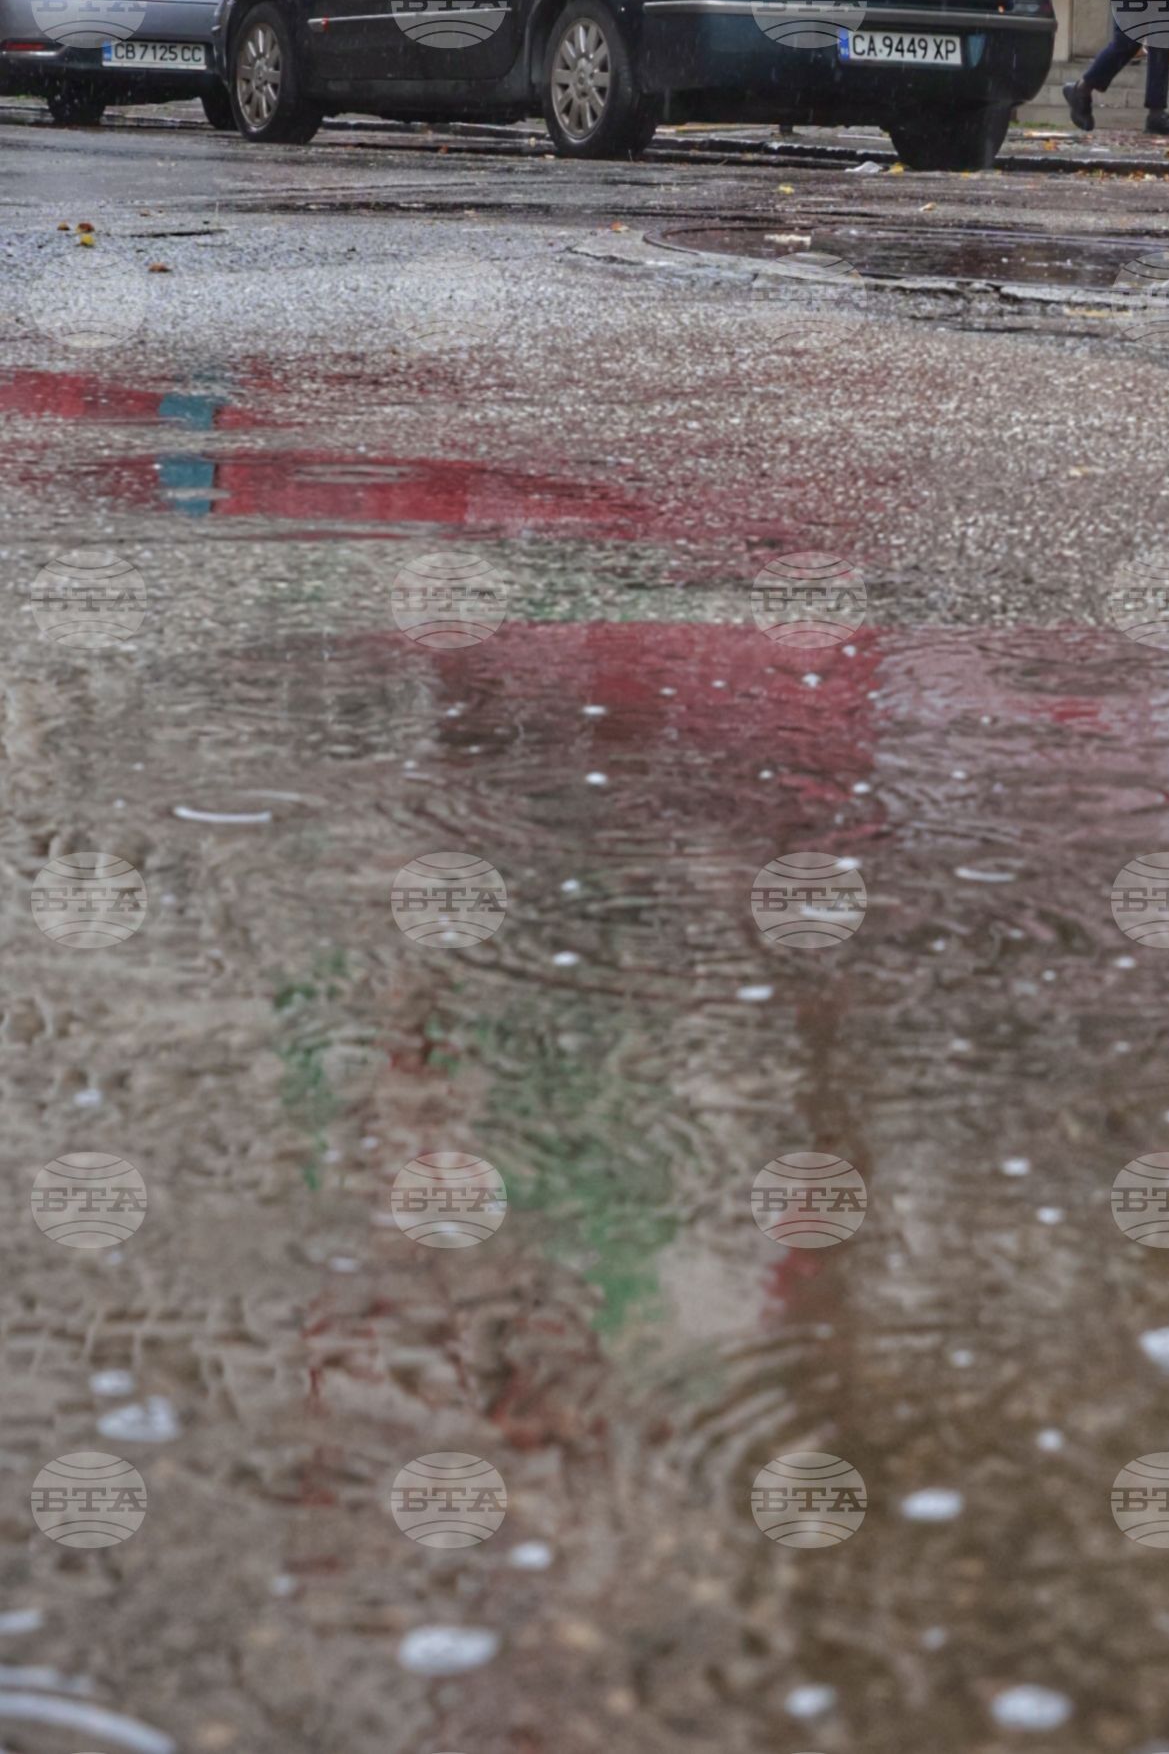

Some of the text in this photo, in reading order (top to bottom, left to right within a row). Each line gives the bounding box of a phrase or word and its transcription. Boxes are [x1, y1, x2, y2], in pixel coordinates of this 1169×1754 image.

[114, 43, 202, 62] CB 7125 CC
[881, 36, 928, 60] 9449
[932, 38, 957, 61] XP
